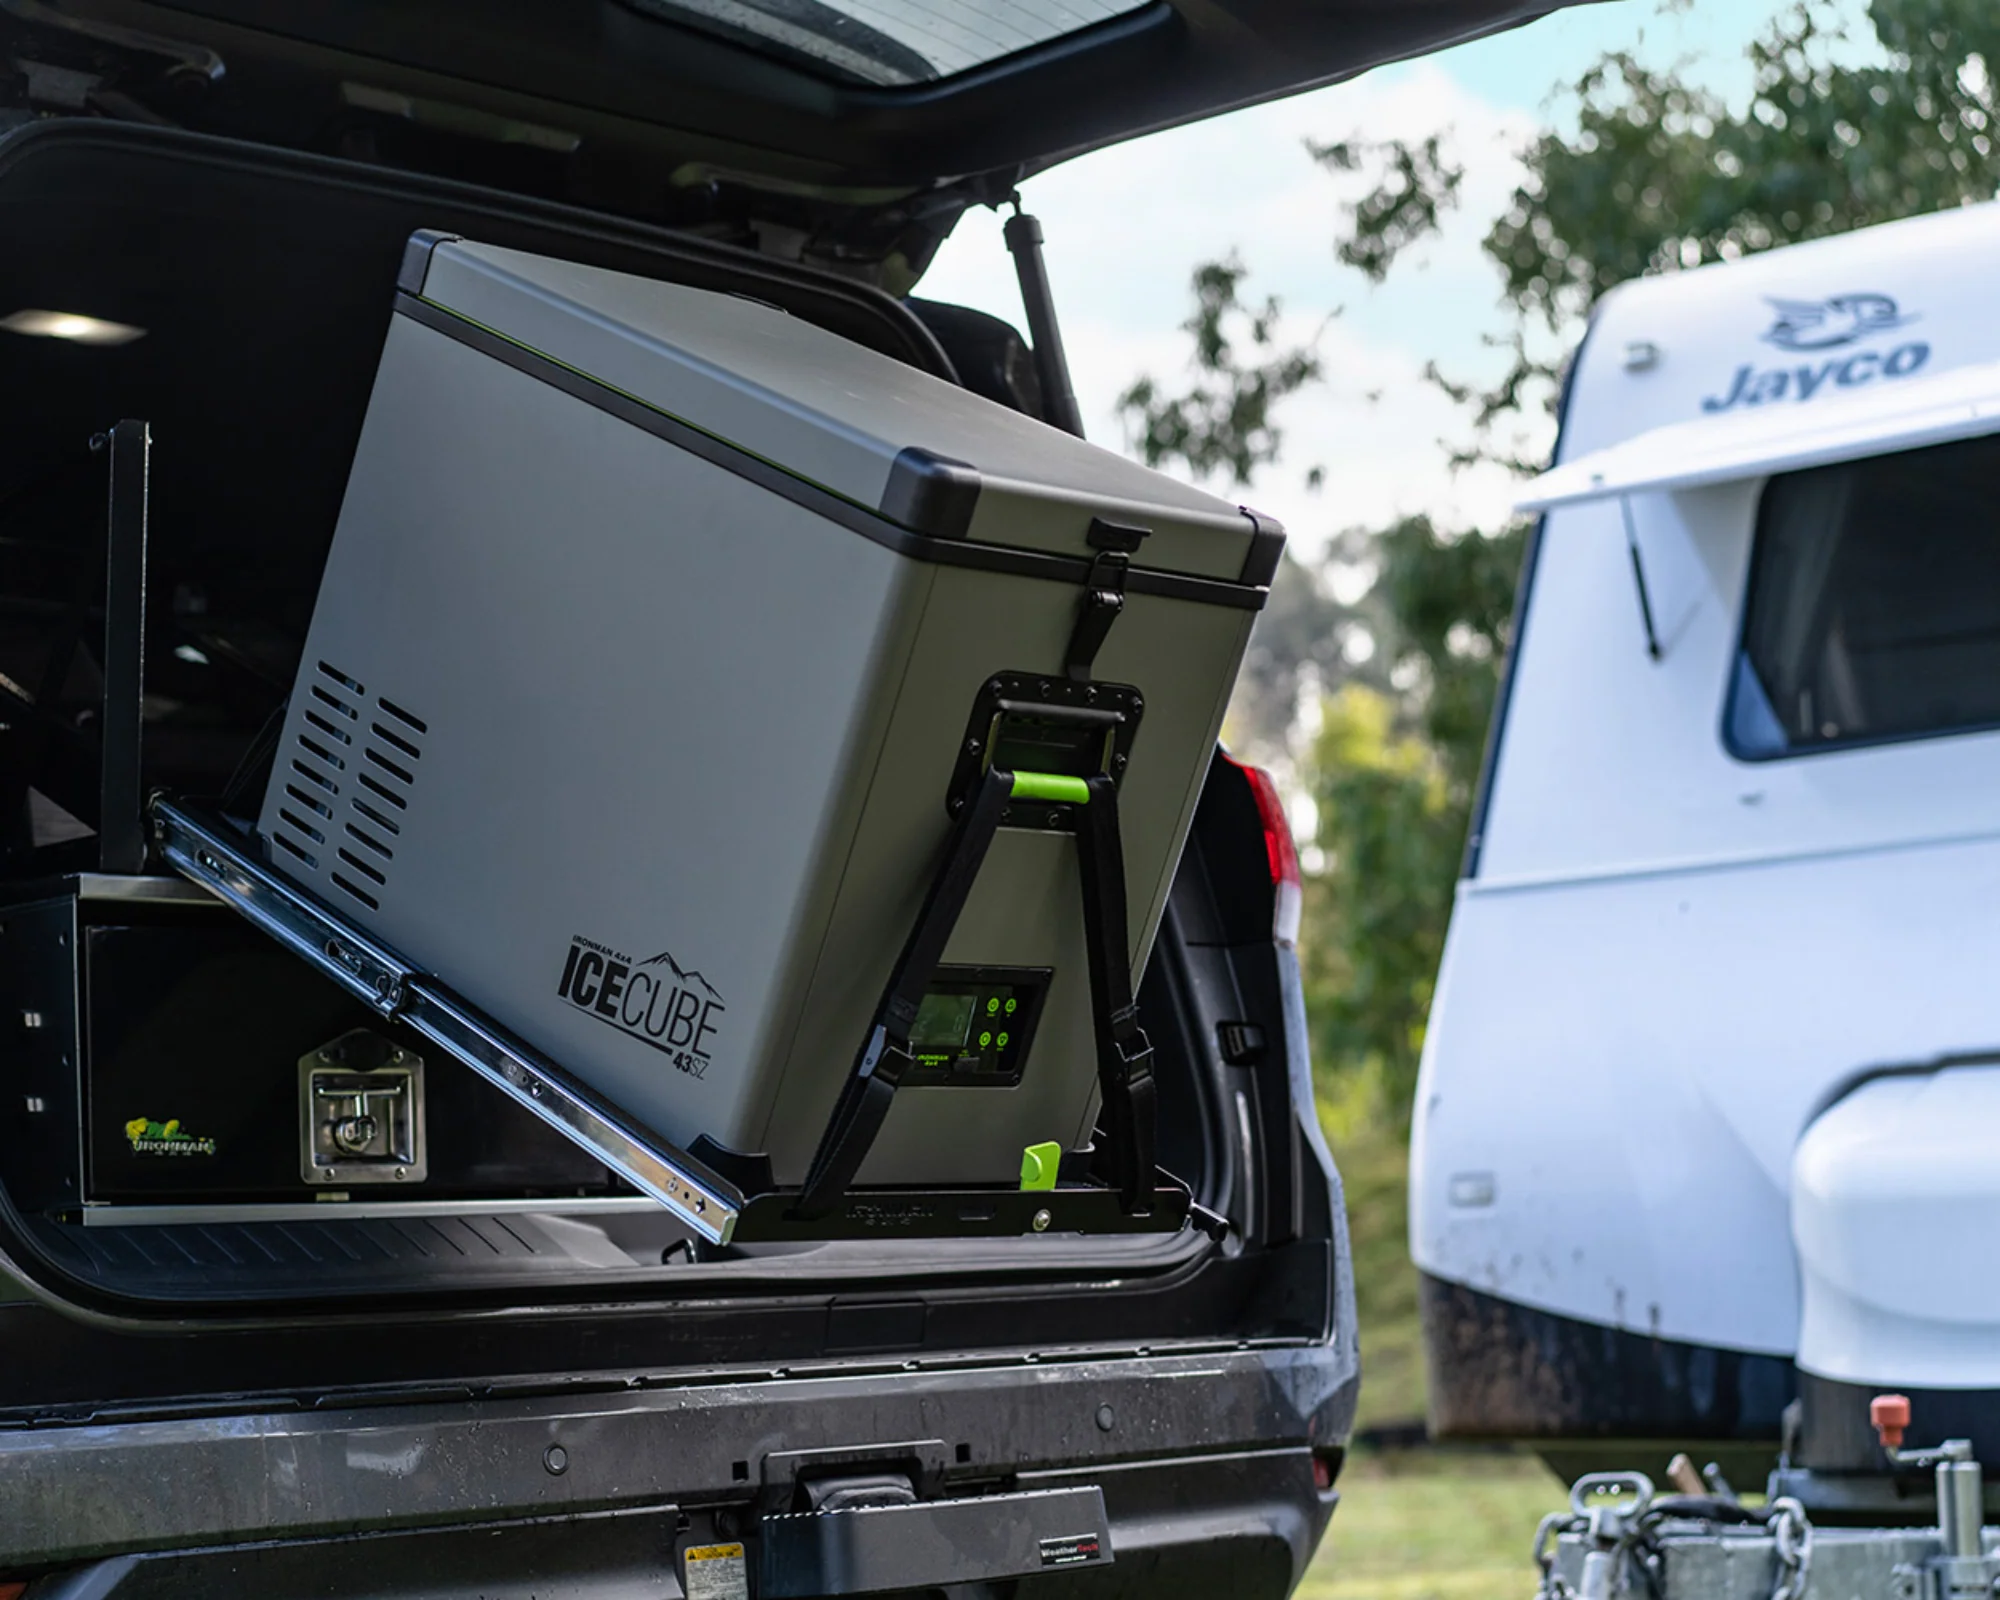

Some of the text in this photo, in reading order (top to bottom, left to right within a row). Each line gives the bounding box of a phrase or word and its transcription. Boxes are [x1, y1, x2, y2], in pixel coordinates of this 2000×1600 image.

[1702, 341, 1931, 414] Jayco
[572, 934, 613, 957] IRONMAN
[672, 1052, 709, 1080] 43SZ
